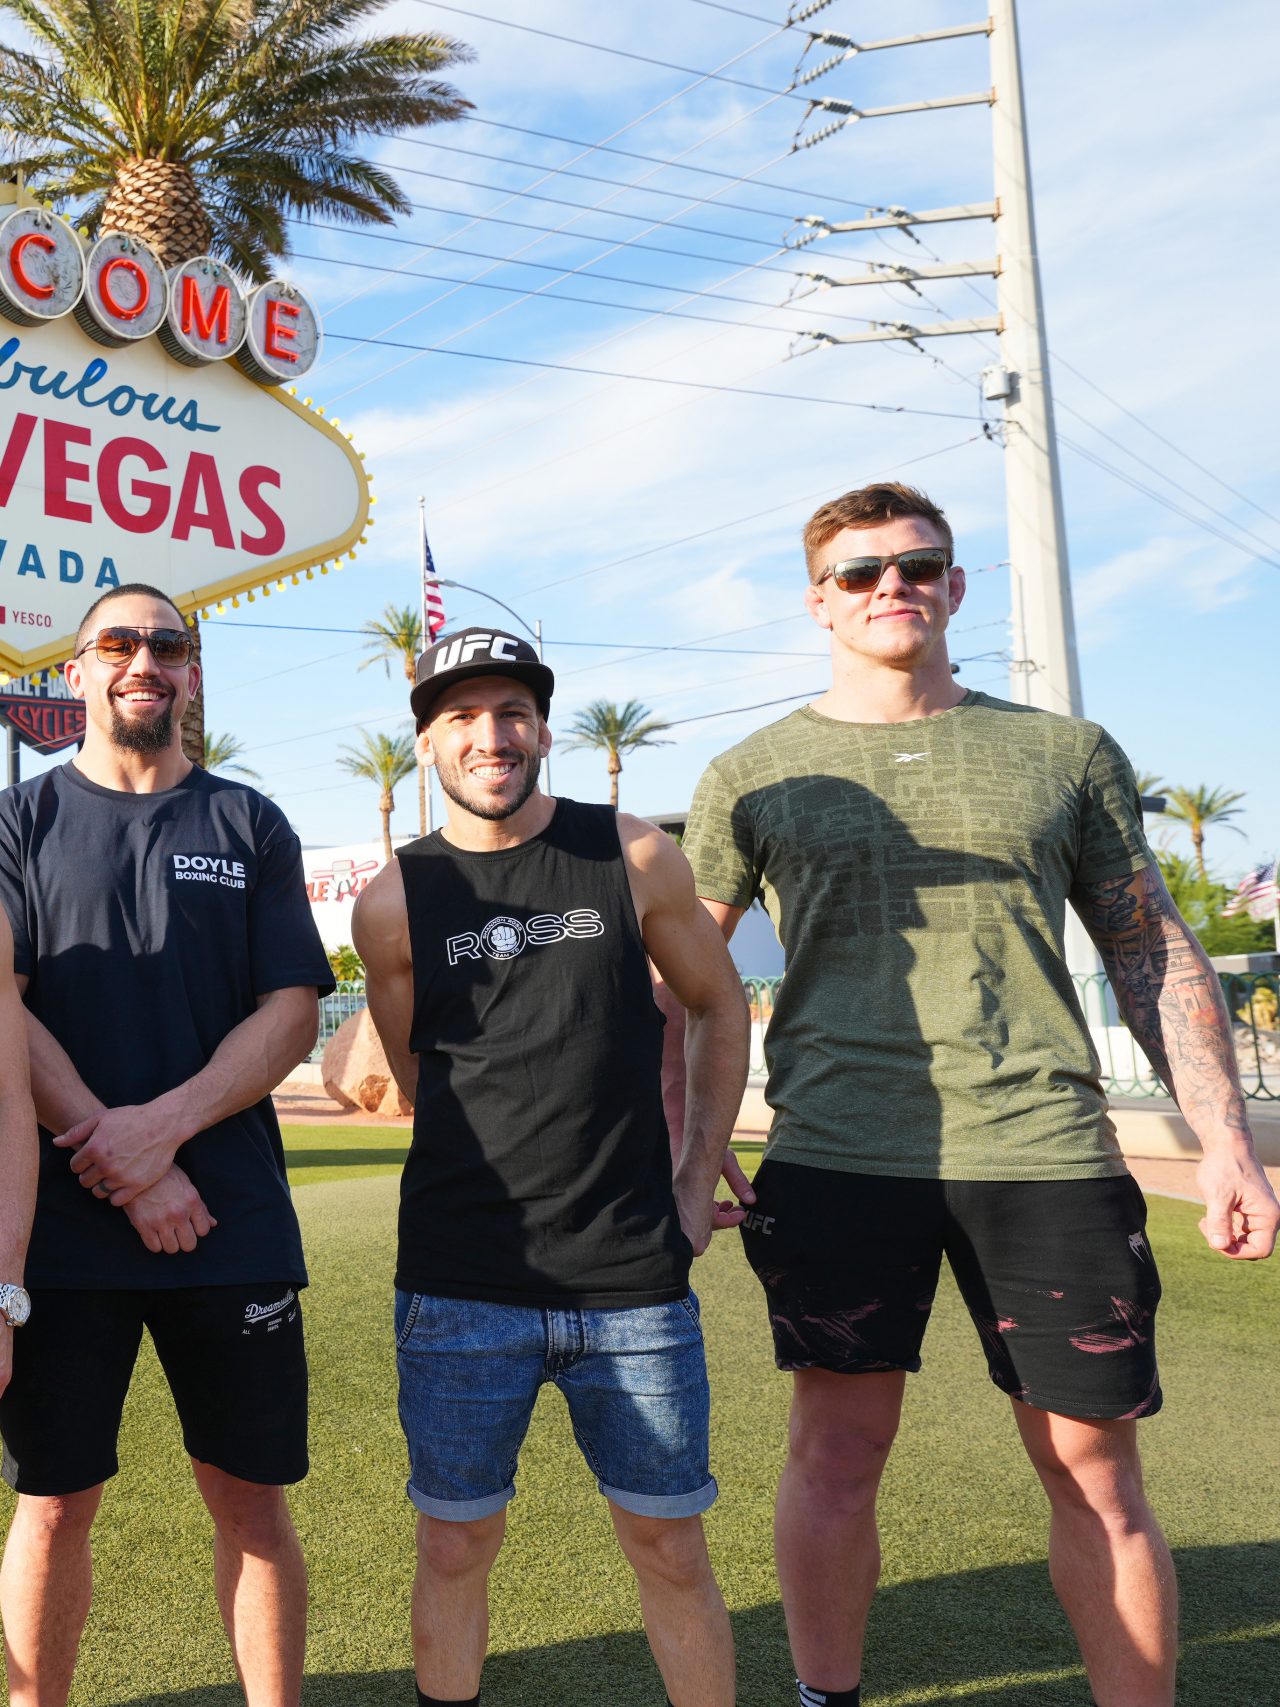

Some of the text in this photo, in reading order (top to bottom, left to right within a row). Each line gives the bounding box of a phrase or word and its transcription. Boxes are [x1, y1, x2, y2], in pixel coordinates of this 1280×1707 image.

[12, 610, 52, 628] YESCO
[433, 633, 518, 674] UFC
[18, 705, 86, 740] CYCLES
[173, 855, 246, 878] DOYLE
[175, 871, 246, 889] BOXING CLUB
[446, 908, 605, 966] ROSS
[482, 918, 506, 939] SHANNON
[742, 1210, 776, 1235] UFC
